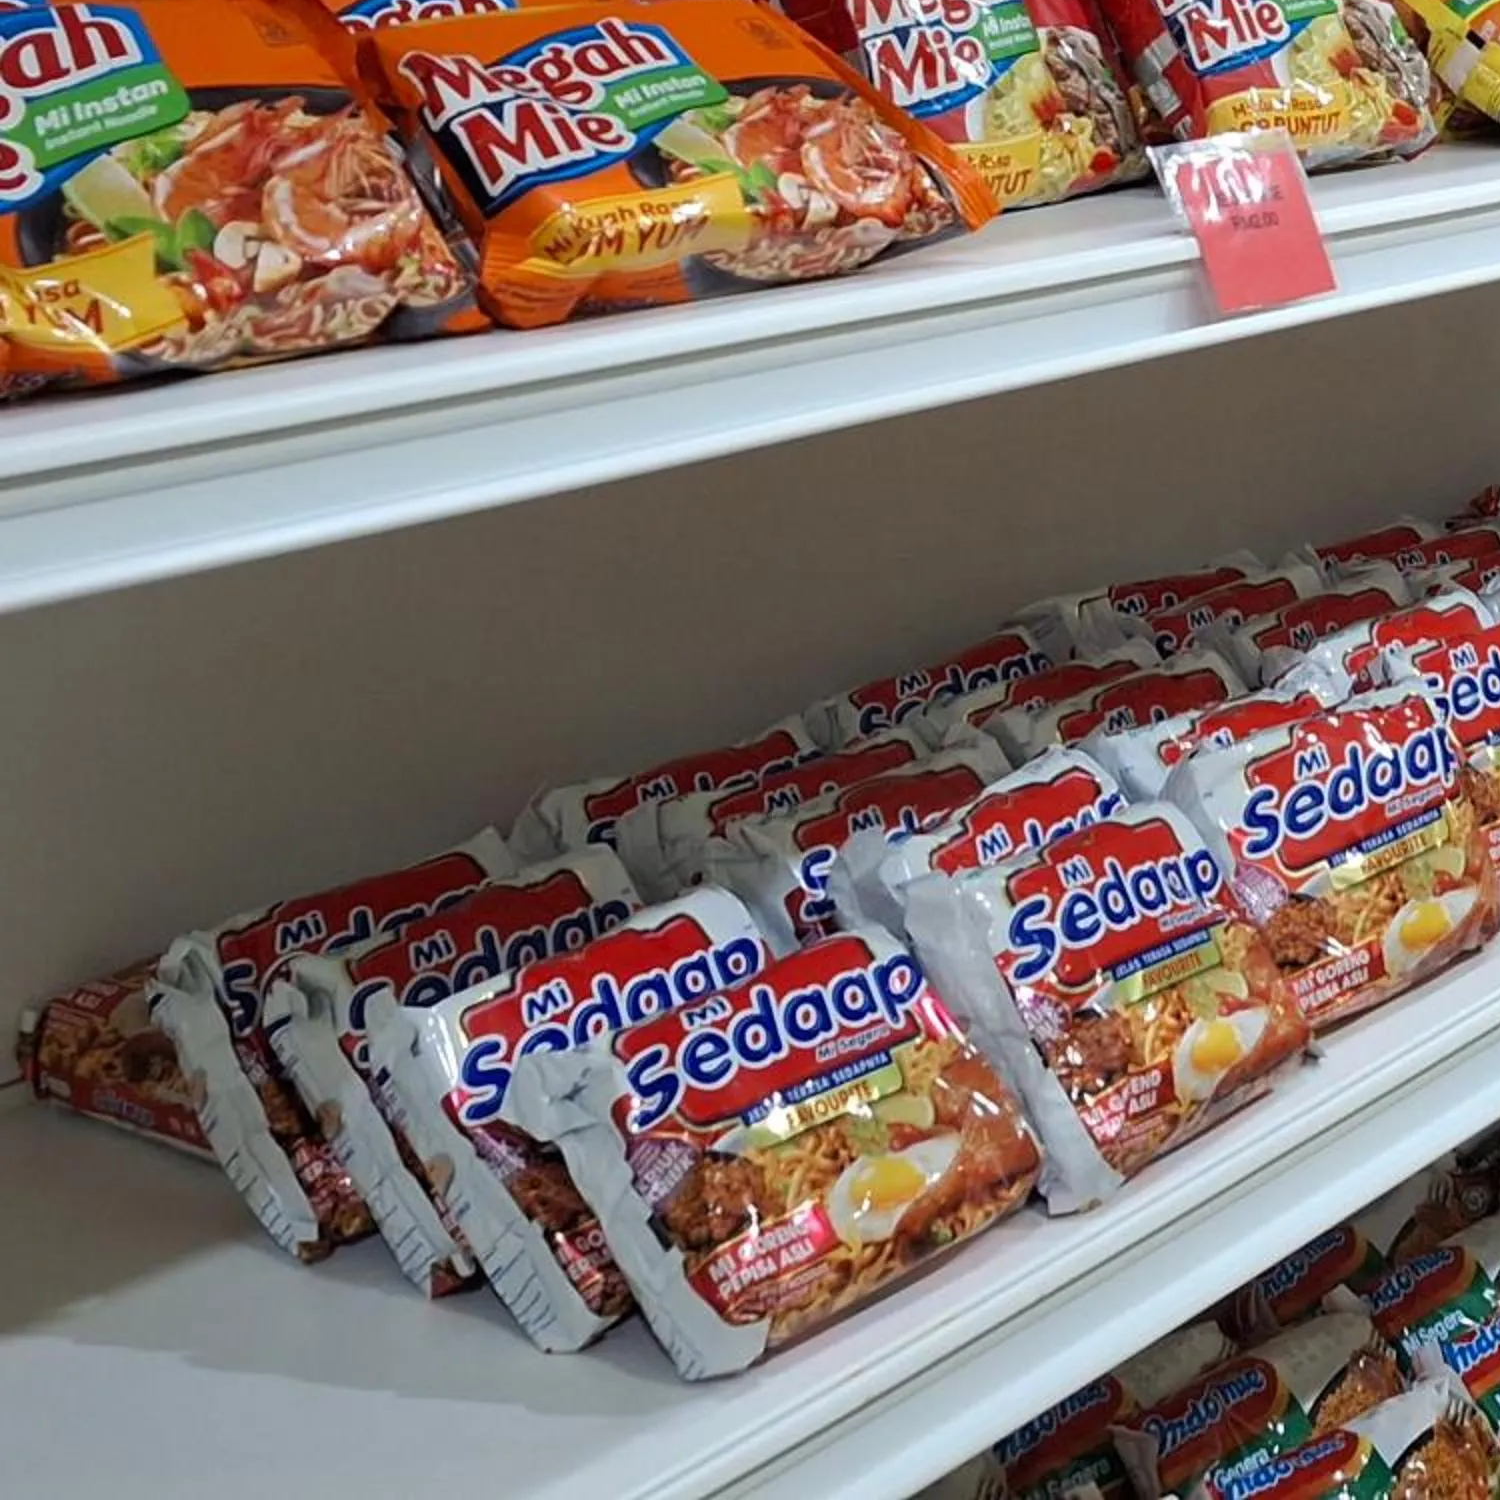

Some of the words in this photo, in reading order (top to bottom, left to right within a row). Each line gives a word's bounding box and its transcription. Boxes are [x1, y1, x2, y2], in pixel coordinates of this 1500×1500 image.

[401, 19, 676, 130] Megah
[864, 27, 988, 106] Mie
[34, 109, 70, 138] Mi
[72, 79, 169, 119] Instan
[612, 87, 640, 109] Mi
[452, 101, 635, 196] Mie
[1452, 644, 1479, 669] Mi
[900, 670, 930, 697] Mi
[1296, 743, 1329, 781] Mi
[1242, 725, 1460, 858] Sedaap
[975, 822, 1013, 861] Mi
[1057, 857, 1093, 888] Mi
[277, 911, 325, 952] Mi
[1008, 846, 1220, 982] Sedaap
[412, 929, 455, 969] Mi
[525, 981, 573, 1024] Mi
[681, 996, 732, 1030] Mi
[626, 953, 926, 1133] Sedaap
[707, 1252, 738, 1283] MI
[777, 1240, 815, 1272] ASLI
